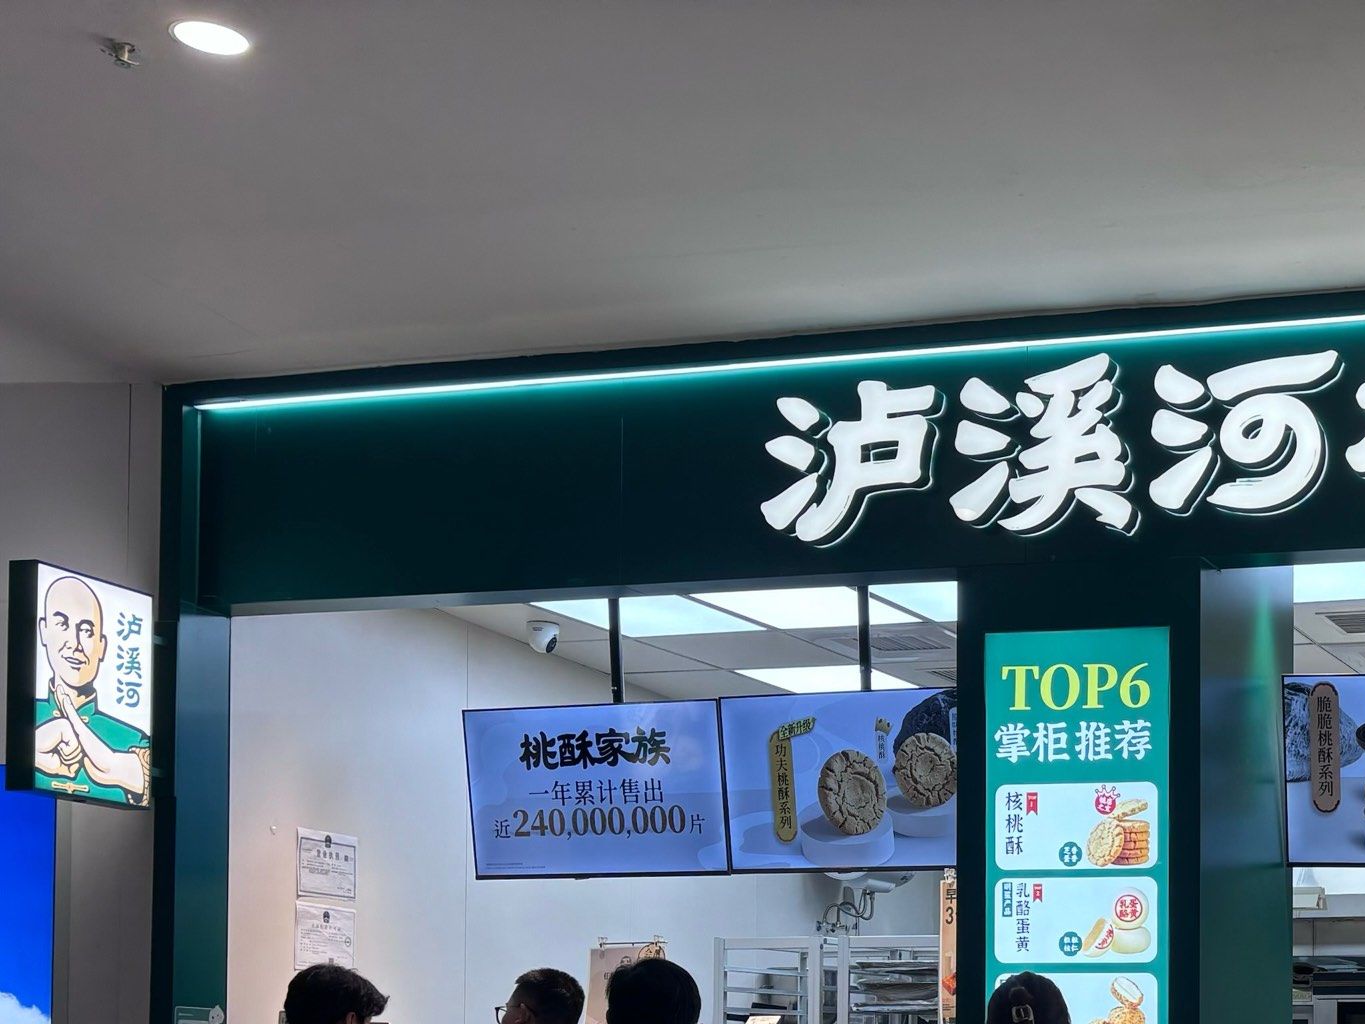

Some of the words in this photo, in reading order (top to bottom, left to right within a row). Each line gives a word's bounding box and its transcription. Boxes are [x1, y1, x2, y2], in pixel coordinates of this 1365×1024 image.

[116, 612, 143, 708] 泸溪河
[1002, 662, 1151, 711] TOP6
[518, 726, 671, 770] 桃酥家族
[994, 719, 1152, 763] 掌柜推荐
[1317, 696, 1333, 797] 脆脆桃酥系列
[528, 777, 664, 806] 一年累计售出
[775, 743, 792, 829] 功夫桃酥系列
[493, 804, 706, 840] 近240,000,000片
[1005, 792, 1024, 855] 核桃酥
[1016, 882, 1031, 952] 乳酪蛋黄
